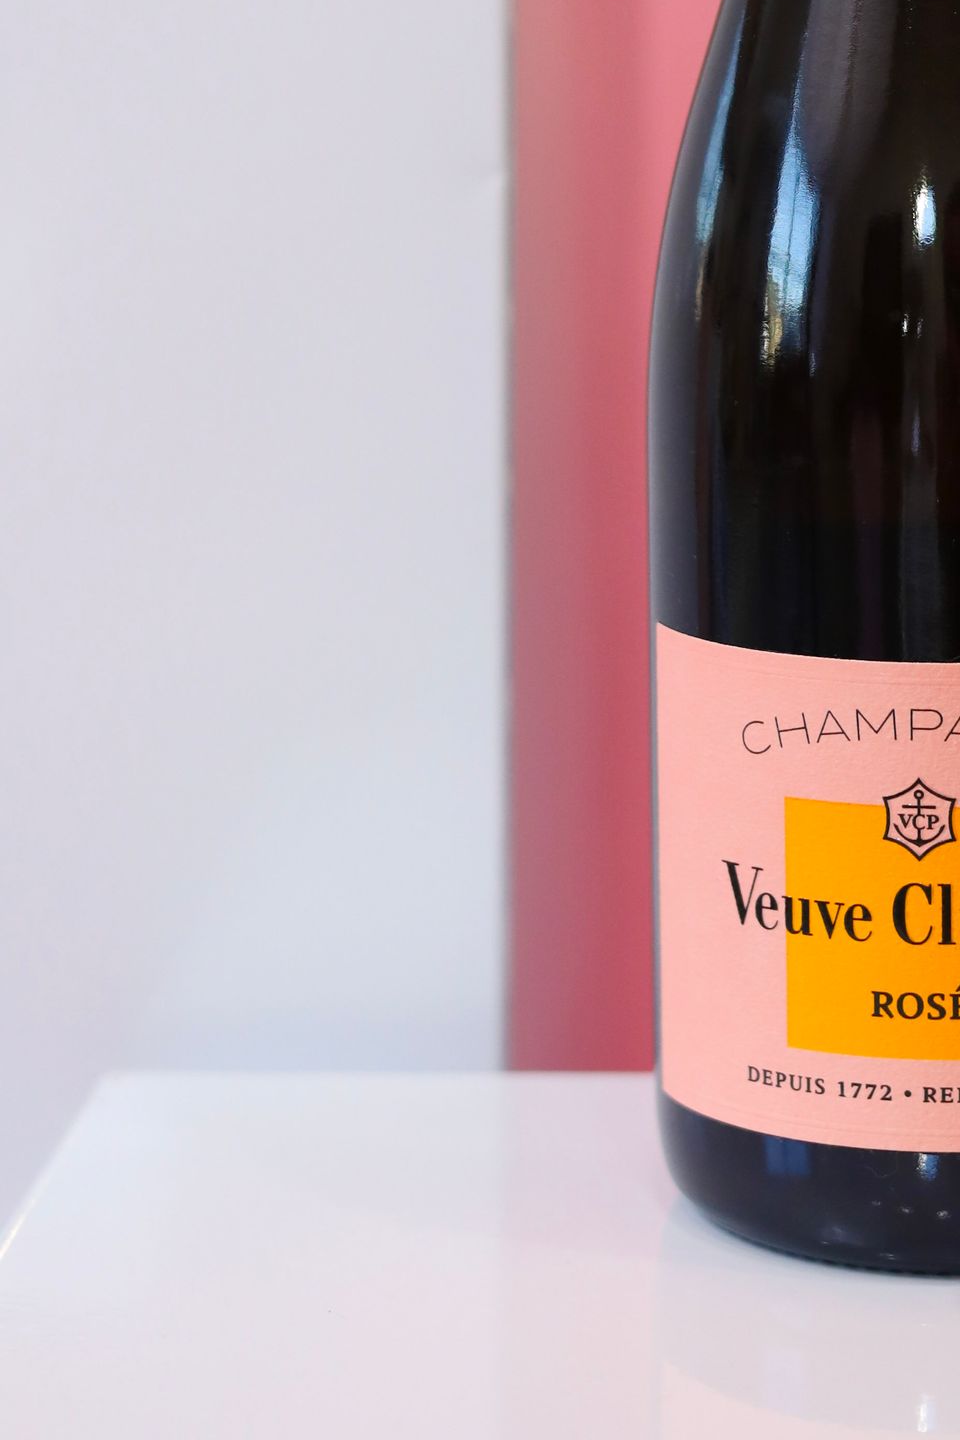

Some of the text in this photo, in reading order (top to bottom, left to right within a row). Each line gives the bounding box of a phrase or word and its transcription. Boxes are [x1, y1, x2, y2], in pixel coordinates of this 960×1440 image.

[897, 812, 940, 831] VCP
[721, 858, 874, 942] Veuve
[747, 1065, 826, 1095] DEPUIS
[837, 1081, 894, 1102] 1772
